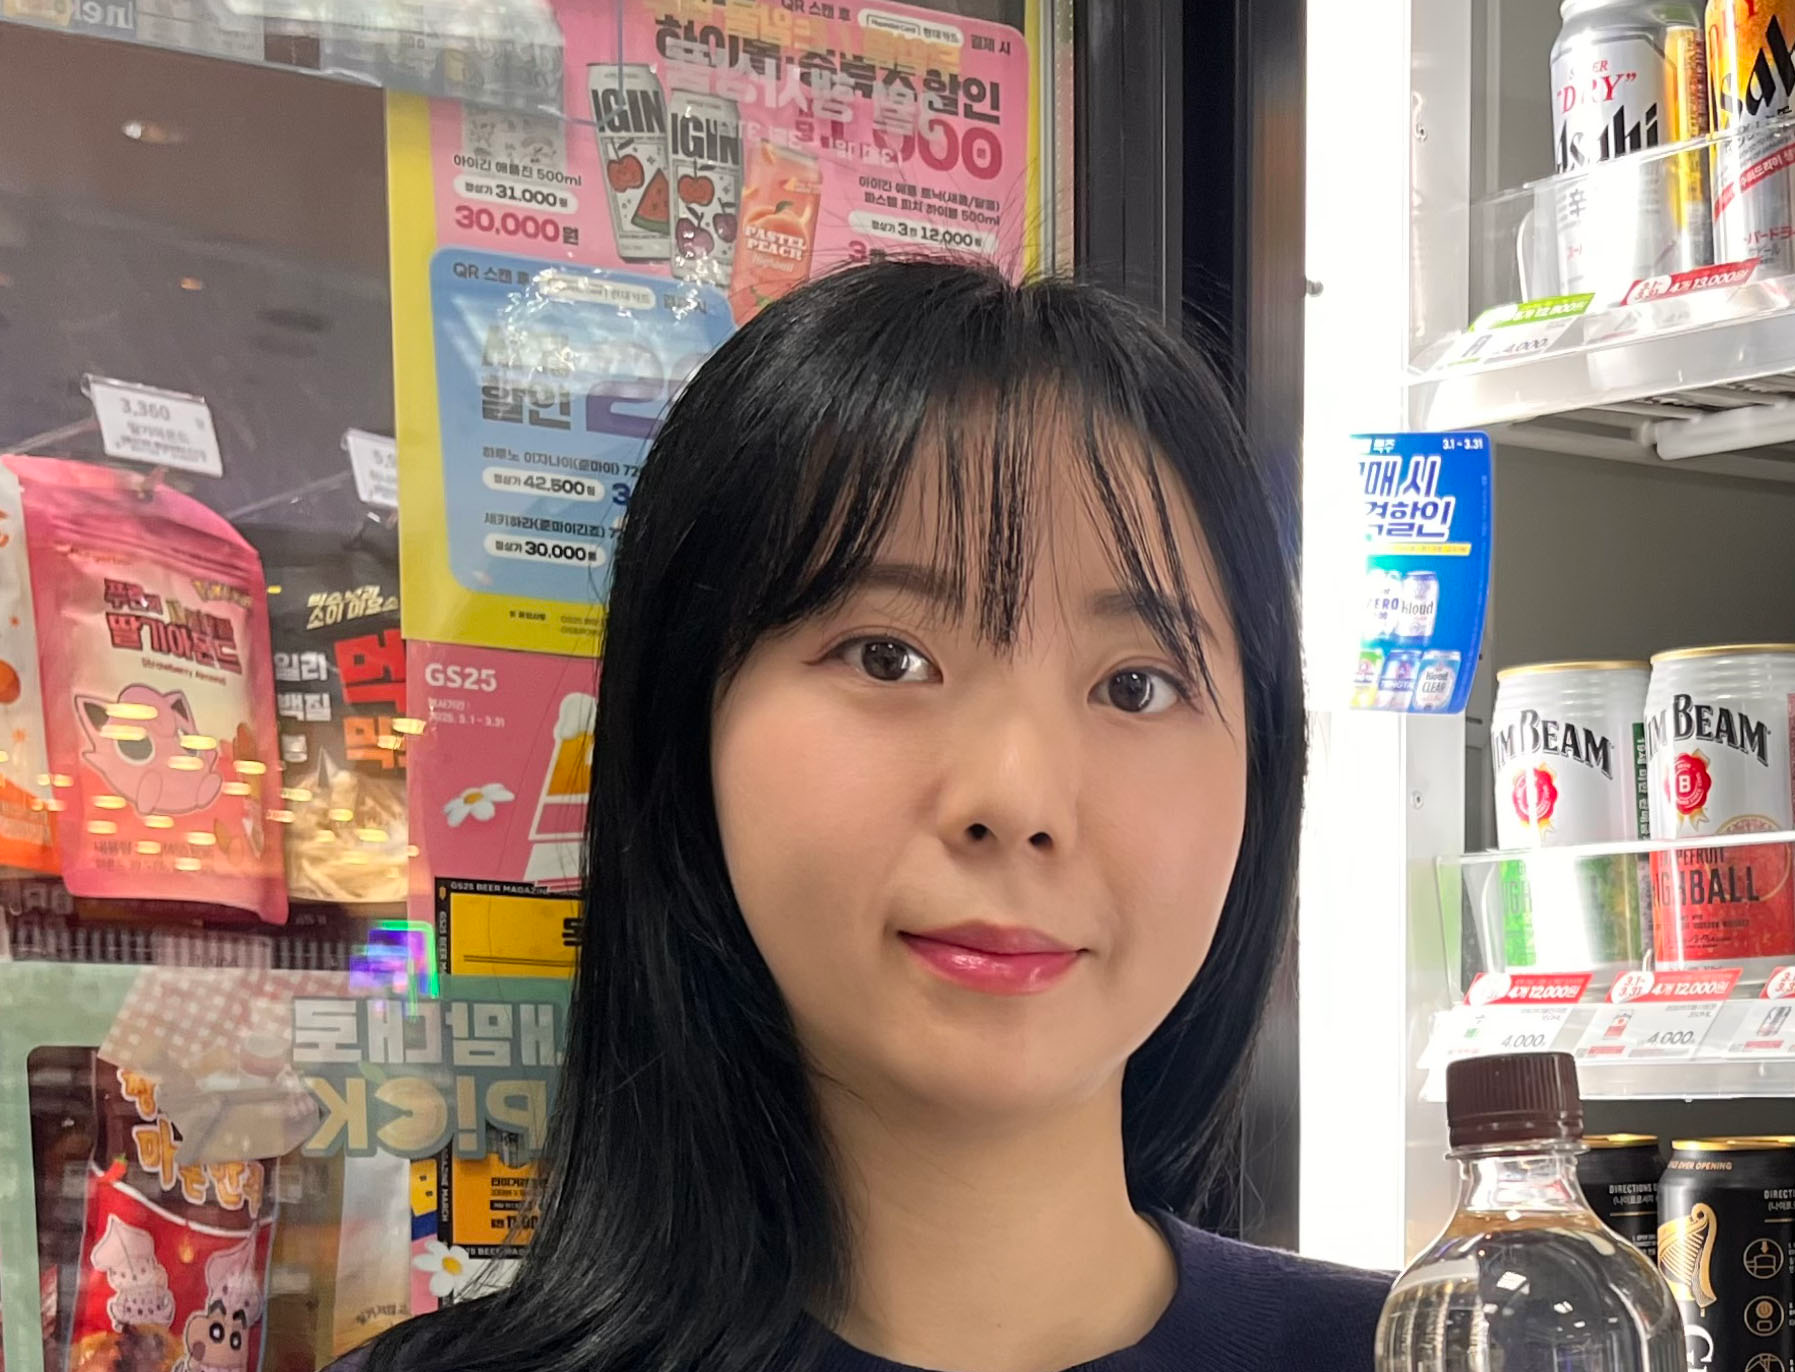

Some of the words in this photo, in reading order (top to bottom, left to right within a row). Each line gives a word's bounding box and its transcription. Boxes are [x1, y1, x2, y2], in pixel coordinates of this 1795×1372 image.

[536, 166, 581, 187] 500ml
[425, 663, 497, 693] GS25
[1673, 694, 1769, 767] BEAM
